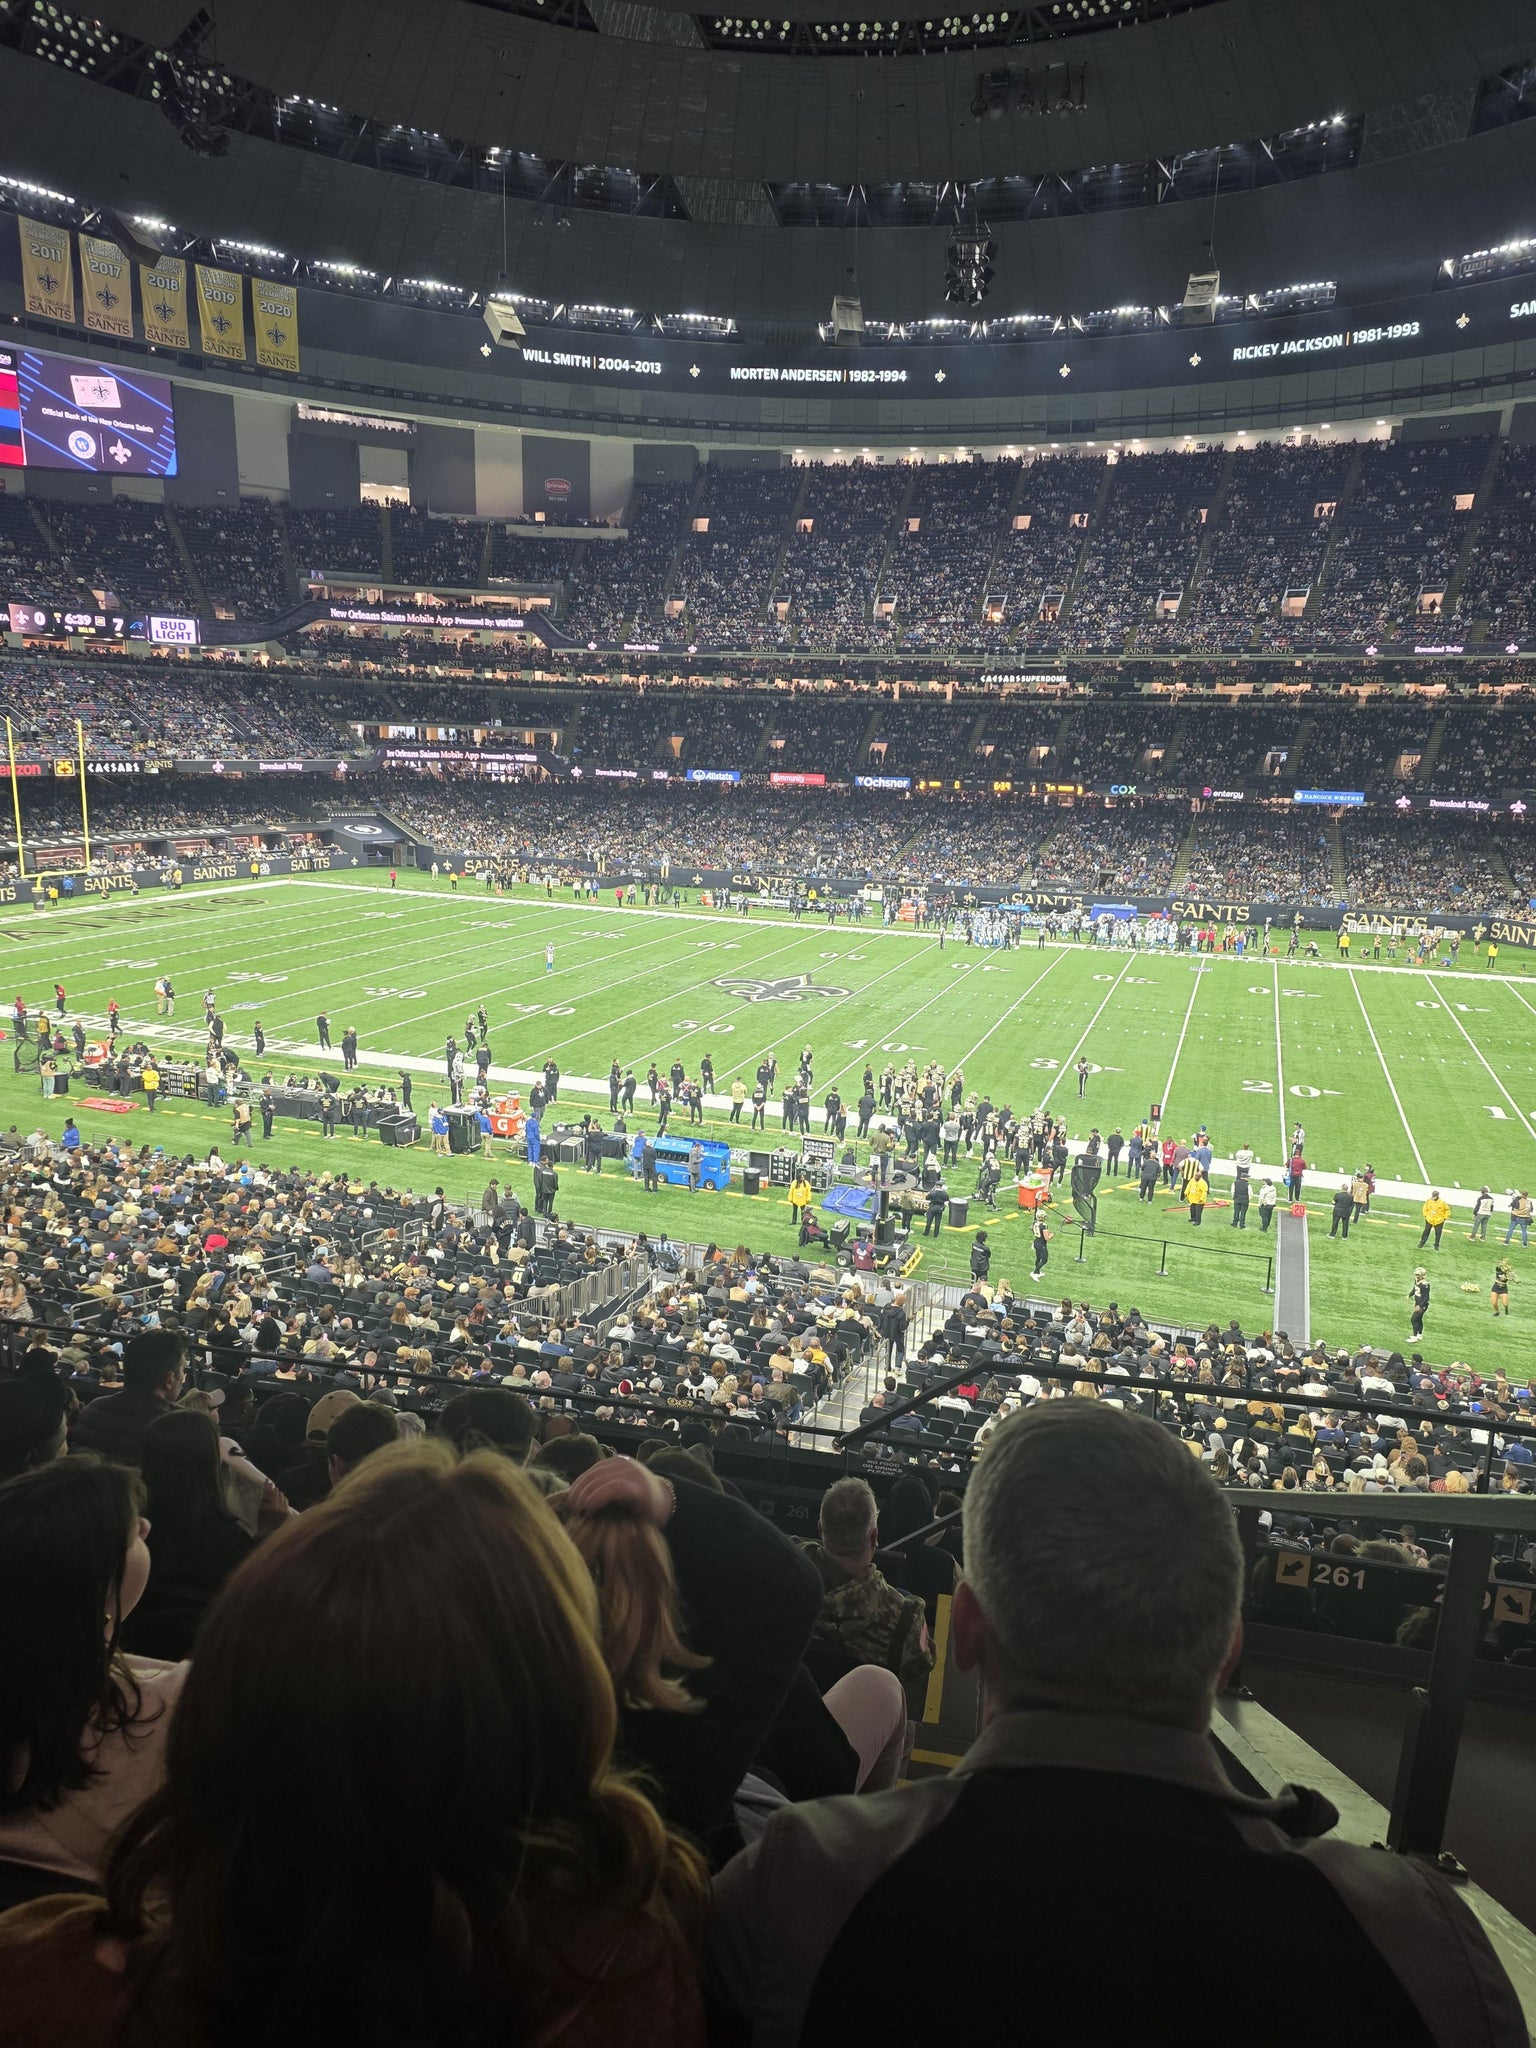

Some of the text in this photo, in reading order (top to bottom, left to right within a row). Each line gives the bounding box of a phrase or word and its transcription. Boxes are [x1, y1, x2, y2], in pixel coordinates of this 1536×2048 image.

[30, 242, 63, 264] 2011
[90, 259, 122, 279] 2017
[148, 273, 180, 292] 2018
[204, 287, 236, 305] 2019
[29, 300, 72, 321] SAINTS
[259, 300, 292, 318] 2020
[88, 316, 130, 335] SAINTS
[147, 329, 187, 346] SAINTS
[1233, 321, 1420, 361] RICKEY JACKSON 1981-1993
[204, 341, 243, 358] SAINTS
[259, 353, 297, 370] SAINTS
[522, 348, 662, 375] WILL SMITH 2004-2013
[730, 367, 907, 384] MORTEN ANDERSEN 1982-1994
[41, 407, 154, 433] Official Bank of the New Orleans Saints
[33, 610, 46, 626] 0
[112, 617, 124, 631] 7
[330, 607, 347, 618] New
[348, 609, 380, 621] Orleans
[381, 612, 406, 622] Saints
[406, 613, 434, 624] Mobile
[435, 615, 453, 626] App
[455, 616, 484, 626] Presented
[495, 618, 524, 628] verizon
[160, 621, 187, 631] BUD
[155, 630, 192, 641] LIGHT
[750, 645, 777, 653] SAINTS
[810, 645, 837, 654] SAINTS
[868, 646, 896, 655] SAINTS
[930, 647, 958, 655] SAINTS
[1123, 646, 1153, 655] SAINTS
[1191, 646, 1223, 655] SAINTS
[1261, 646, 1294, 654] SAINTS
[1414, 646, 1445, 654] Download
[980, 675, 1067, 683] CAESARS SUPERDOME
[419, 750, 440, 759] Saints
[440, 750, 464, 760] Mobile
[464, 751, 480, 761] App
[87, 762, 140, 774] CAESARS
[145, 760, 173, 769] SAINTS
[259, 762, 304, 771] Download Today
[595, 769, 621, 778] Download
[705, 771, 735, 781] Allstate
[863, 776, 909, 788] Ochsner
[1213, 790, 1244, 799] entergy
[1429, 799, 1490, 810] Download Today
[193, 864, 237, 880] SAINTS
[84, 873, 134, 891] SAINTS
[1012, 892, 1083, 909] SAINTS
[1171, 901, 1250, 922] SAINTS
[1343, 912, 1428, 931] SAINTS
[868, 1469, 896, 1477] PLEASE
[875, 1465, 903, 1473] DRINKS
[787, 1504, 809, 1519] 261
[1313, 1563, 1366, 1590] 261
